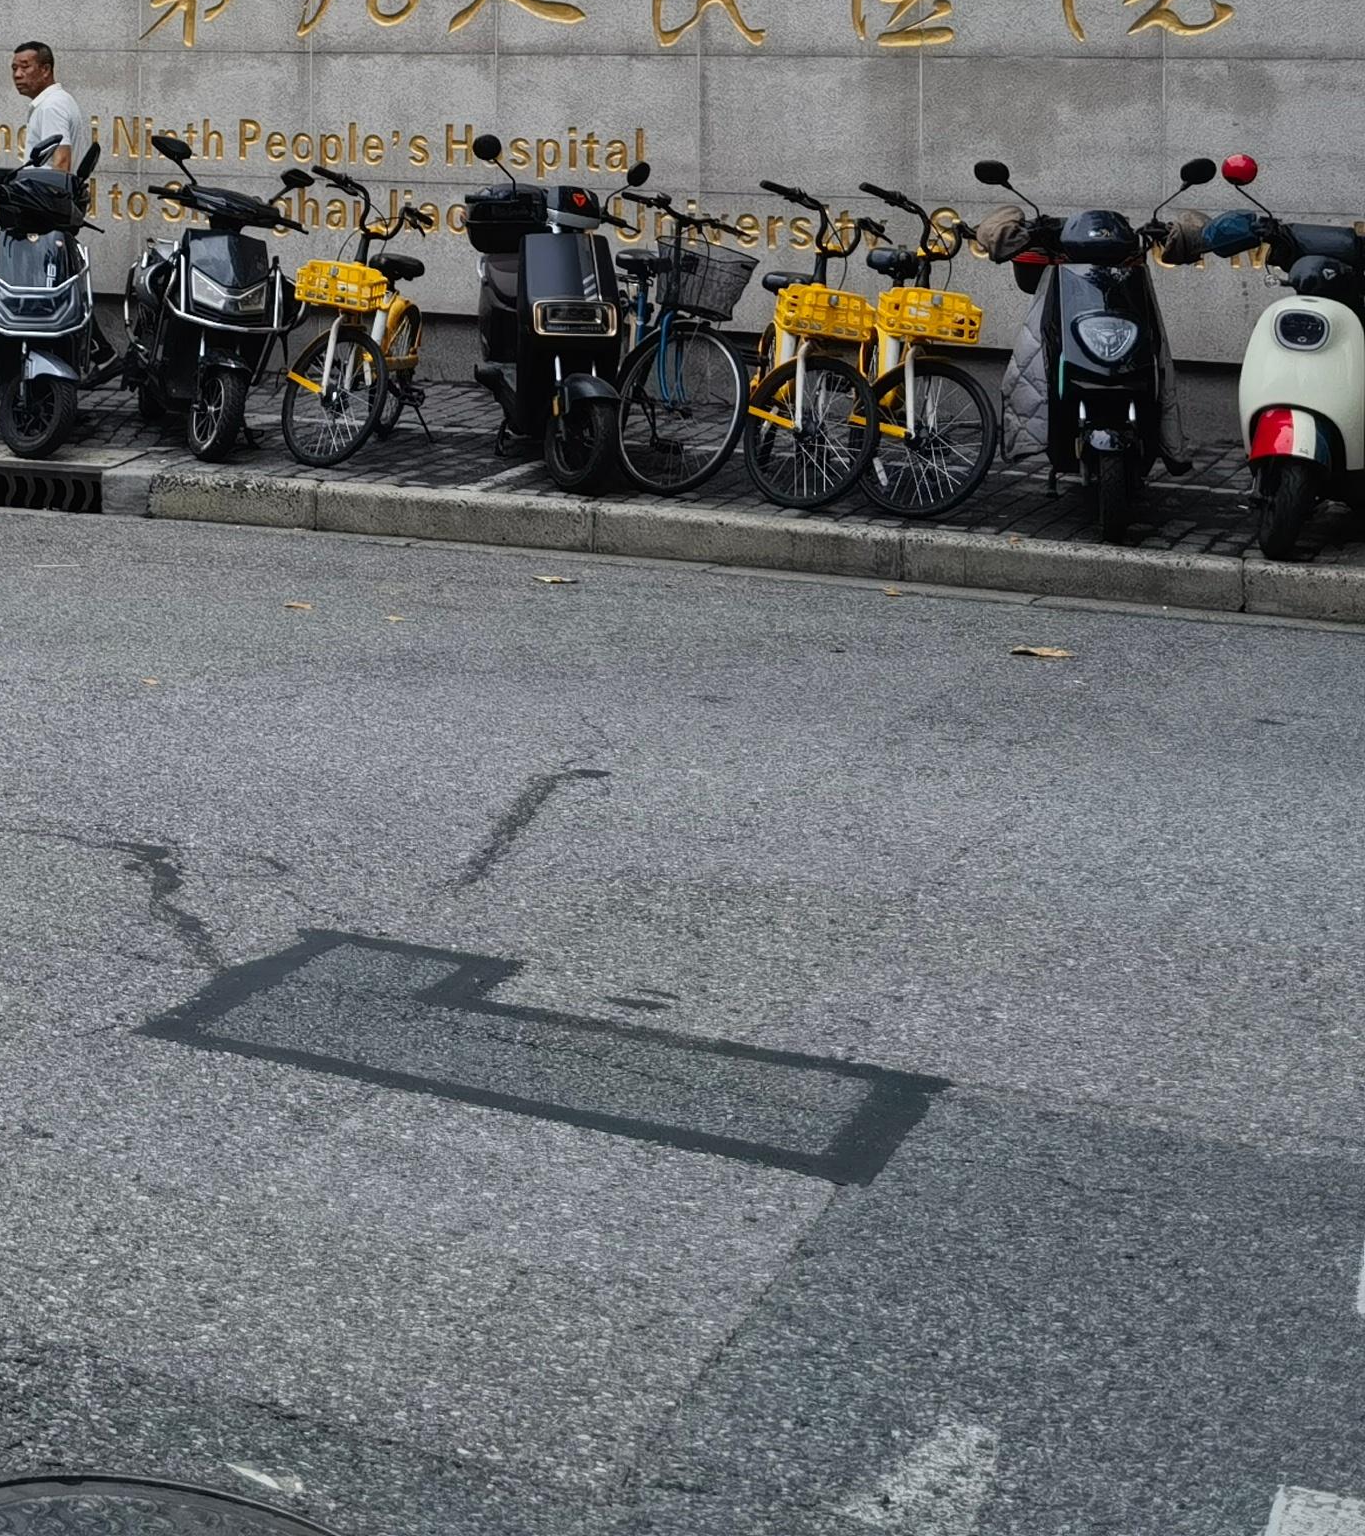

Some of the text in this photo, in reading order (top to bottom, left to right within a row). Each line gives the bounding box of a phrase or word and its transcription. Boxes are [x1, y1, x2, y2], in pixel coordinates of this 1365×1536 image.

[238, 118, 430, 168] People's
[445, 123, 646, 179] Hspital
[108, 183, 148, 221] to
